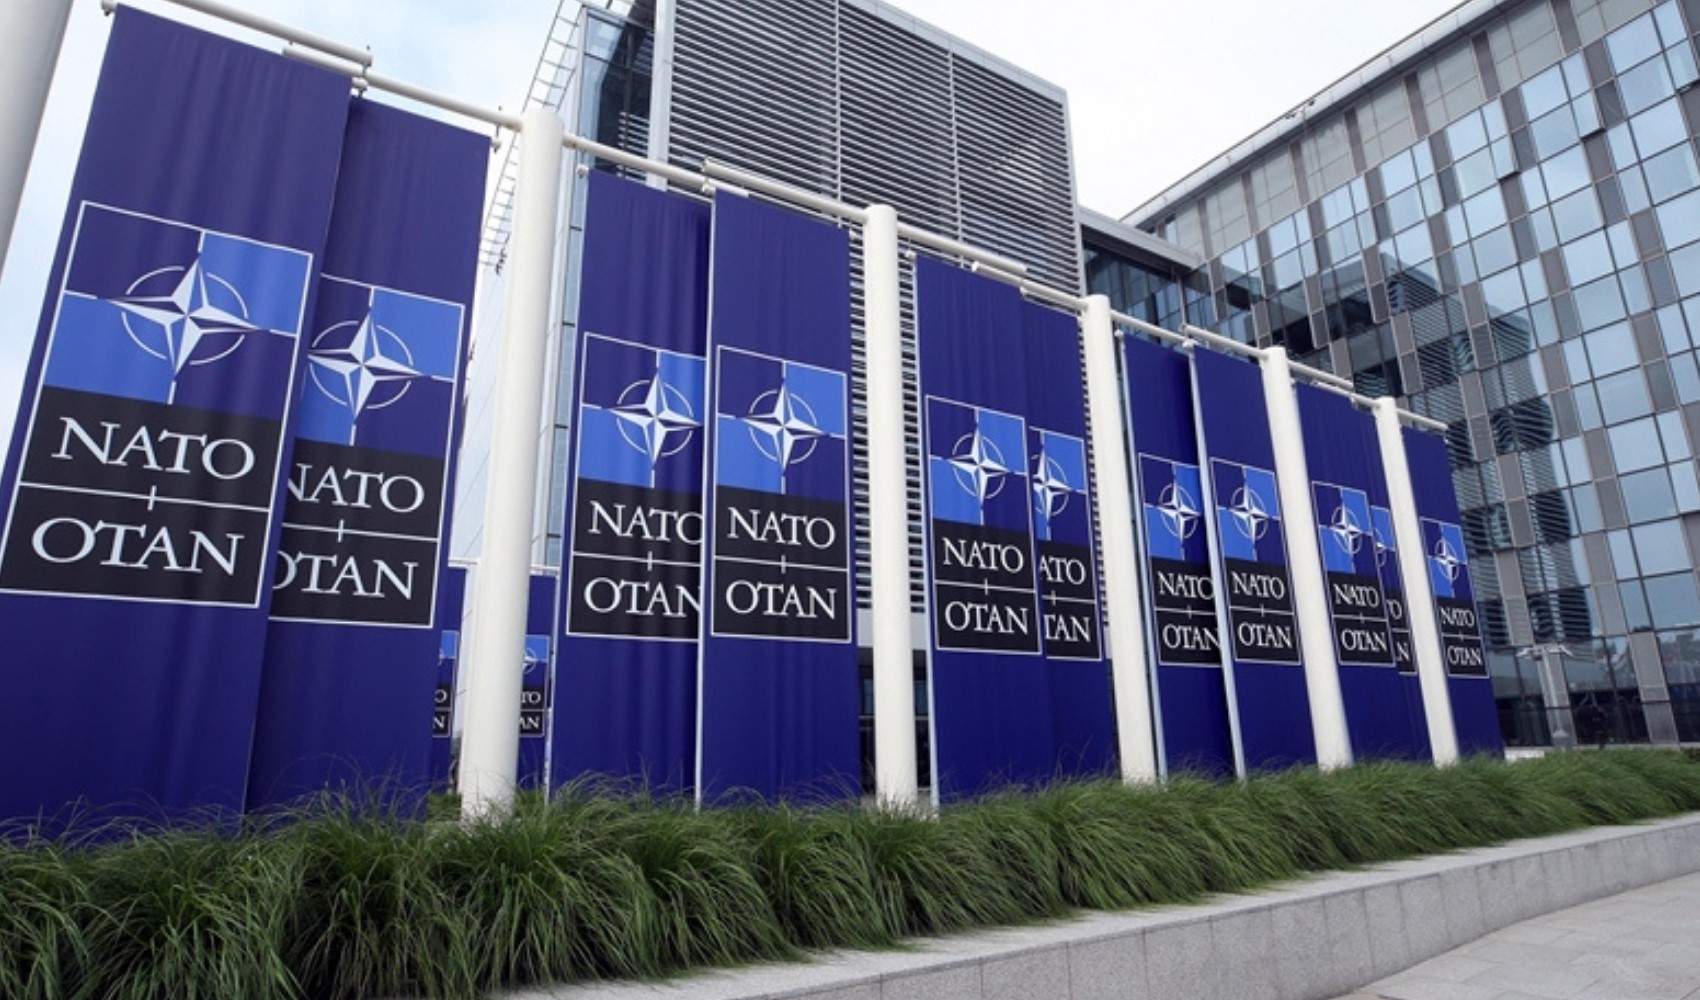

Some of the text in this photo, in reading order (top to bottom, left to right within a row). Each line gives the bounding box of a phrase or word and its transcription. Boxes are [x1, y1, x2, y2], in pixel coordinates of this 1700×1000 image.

[51, 416, 256, 480] NATO
[588, 500, 702, 544] NATO
[727, 506, 836, 549] NATO
[32, 517, 245, 576] OTAN
[941, 537, 1024, 573] NATO
[1038, 555, 1086, 585] ATO
[584, 577, 701, 618] OTAN
[1157, 571, 1214, 600] NATO
[1231, 571, 1285, 599] NATO
[1333, 583, 1379, 607] NATO
[725, 580, 837, 620] OTAN
[944, 600, 1029, 635] OTAN
[1044, 614, 1091, 642] TAN
[1440, 607, 1475, 628] NATO
[1162, 623, 1220, 651] OTAN
[1237, 622, 1292, 648] OTAN
[1341, 629, 1388, 652] OTAN
[1447, 645, 1483, 667] OTAN
[521, 691, 541, 704] TO
